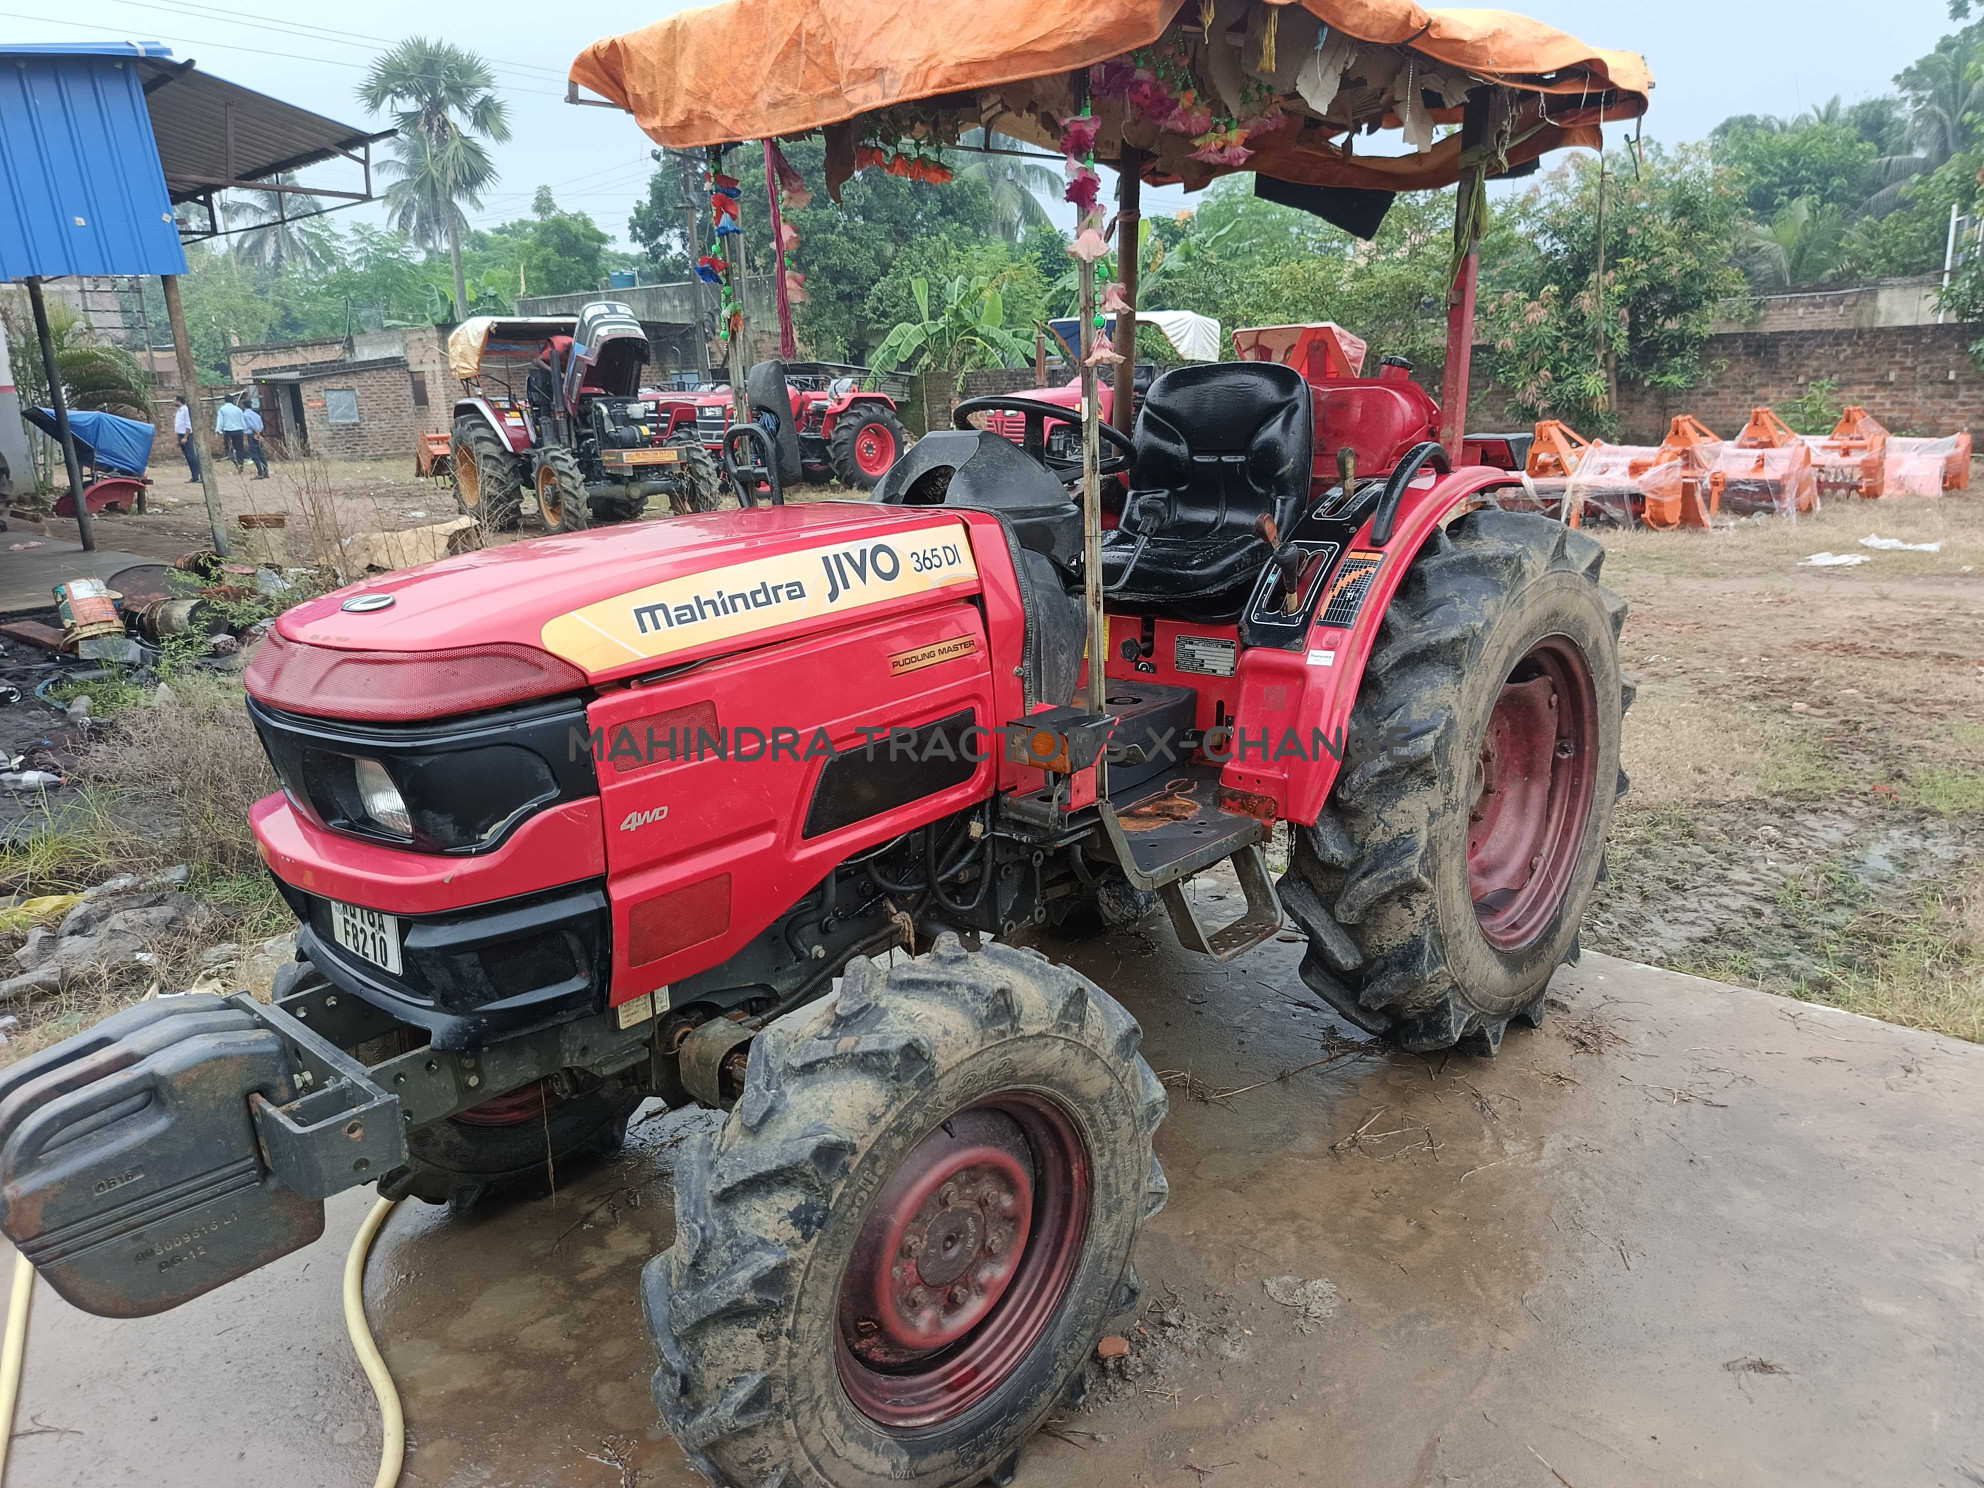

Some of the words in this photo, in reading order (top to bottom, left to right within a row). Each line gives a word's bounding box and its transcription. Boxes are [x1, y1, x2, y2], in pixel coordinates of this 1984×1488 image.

[634, 579, 806, 634] Mahindra
[821, 543, 900, 603] JIVO
[909, 548, 942, 573] 365
[945, 544, 962, 566] DI
[937, 639, 975, 656] MASTER
[620, 805, 669, 831] 4WD
[343, 916, 388, 967] F8210
